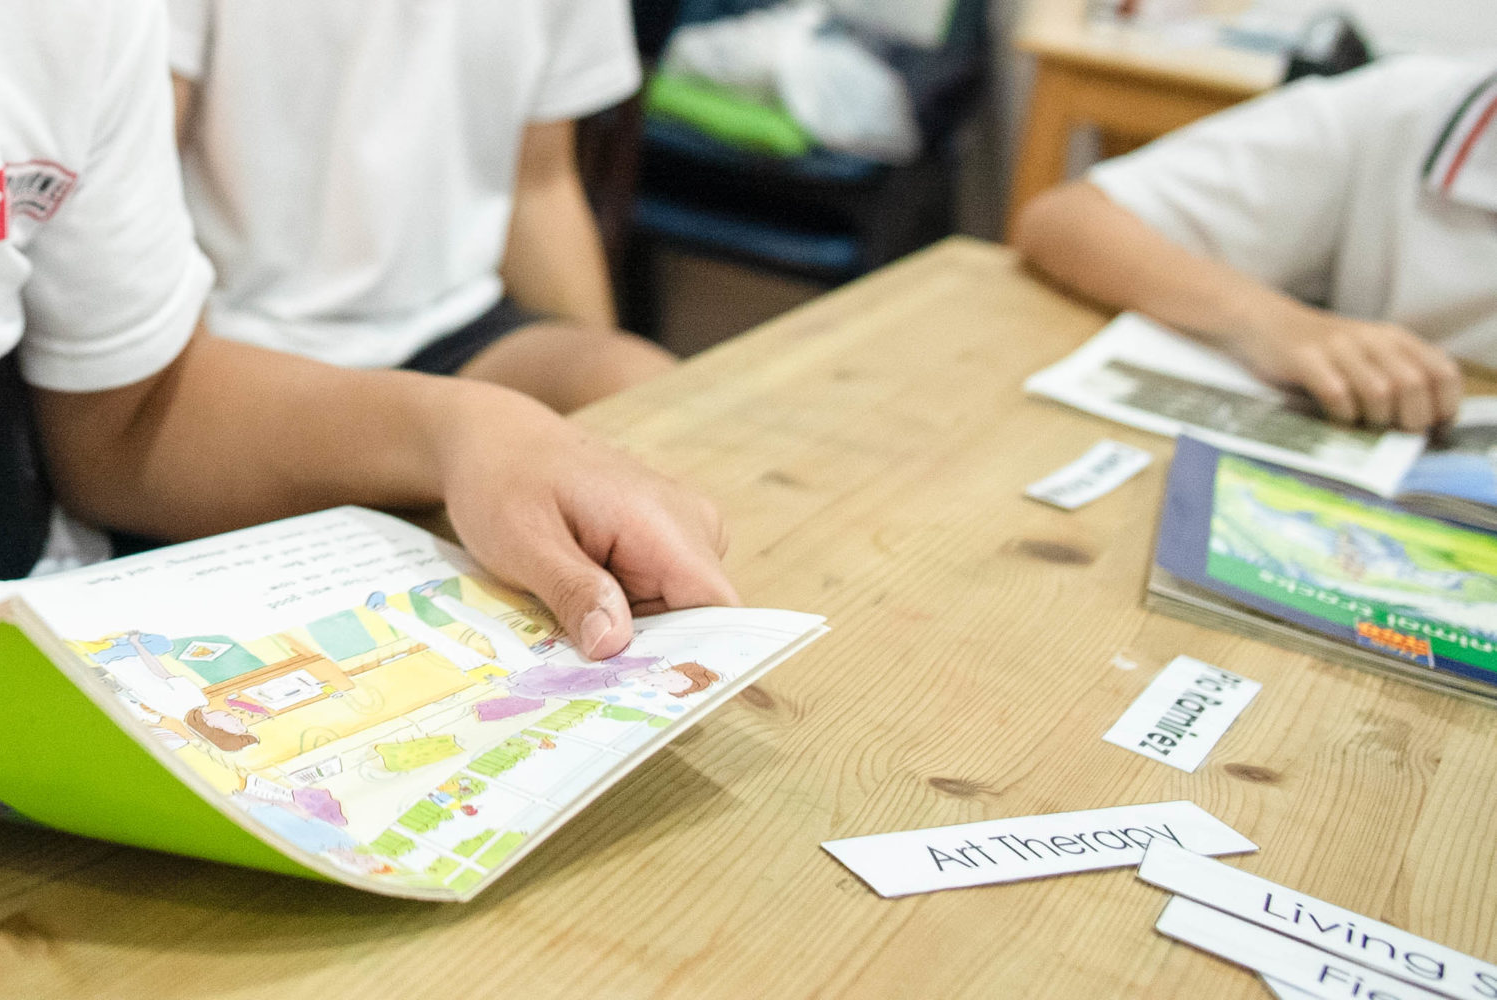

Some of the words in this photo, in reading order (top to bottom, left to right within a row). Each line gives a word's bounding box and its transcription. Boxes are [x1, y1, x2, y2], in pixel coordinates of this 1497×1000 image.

[1386, 611, 1497, 654] nimal
[1137, 688, 1224, 757] Ramirez
[926, 839, 998, 872] Art
[988, 823, 1185, 861] Therapy
[1262, 892, 1445, 980] Living
